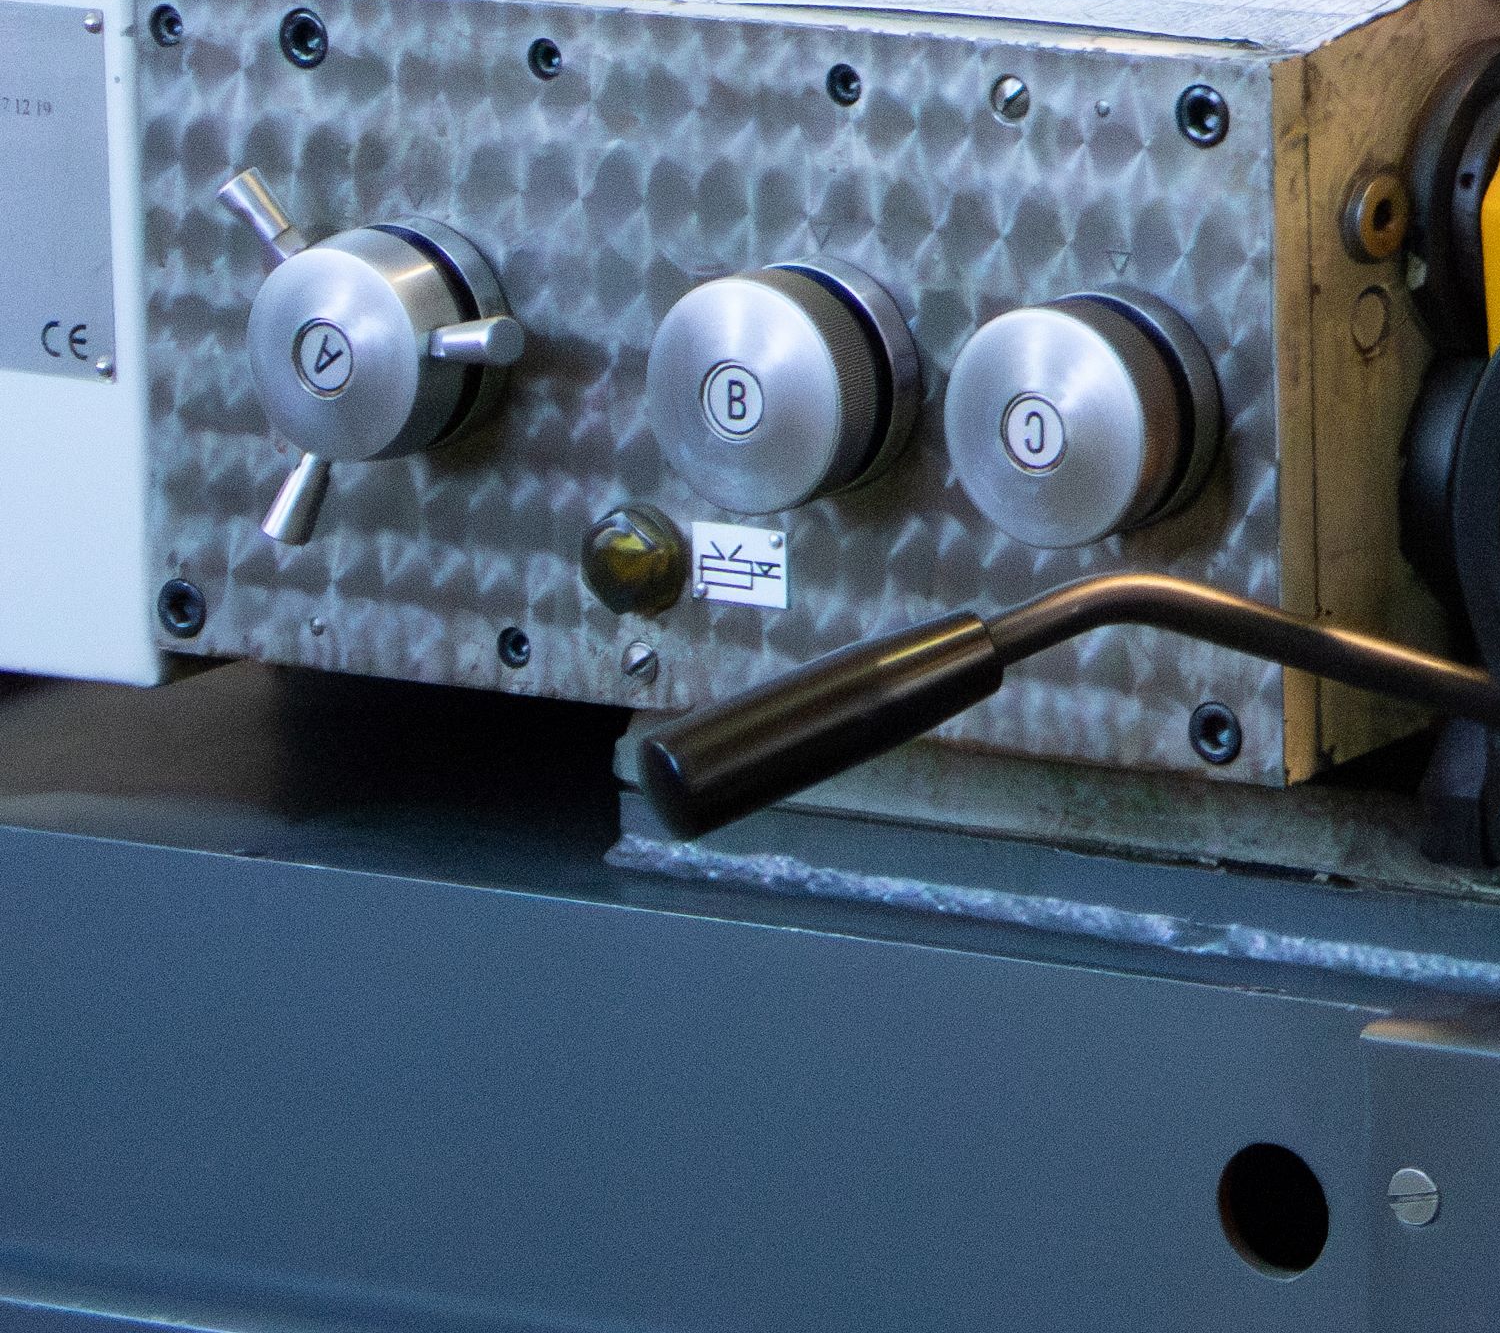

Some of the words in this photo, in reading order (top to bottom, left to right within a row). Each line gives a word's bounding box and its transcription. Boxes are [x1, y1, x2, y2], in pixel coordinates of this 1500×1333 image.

[41, 320, 89, 362] CE
[314, 334, 343, 374] A
[727, 379, 747, 421] B
[1024, 410, 1046, 455] C
